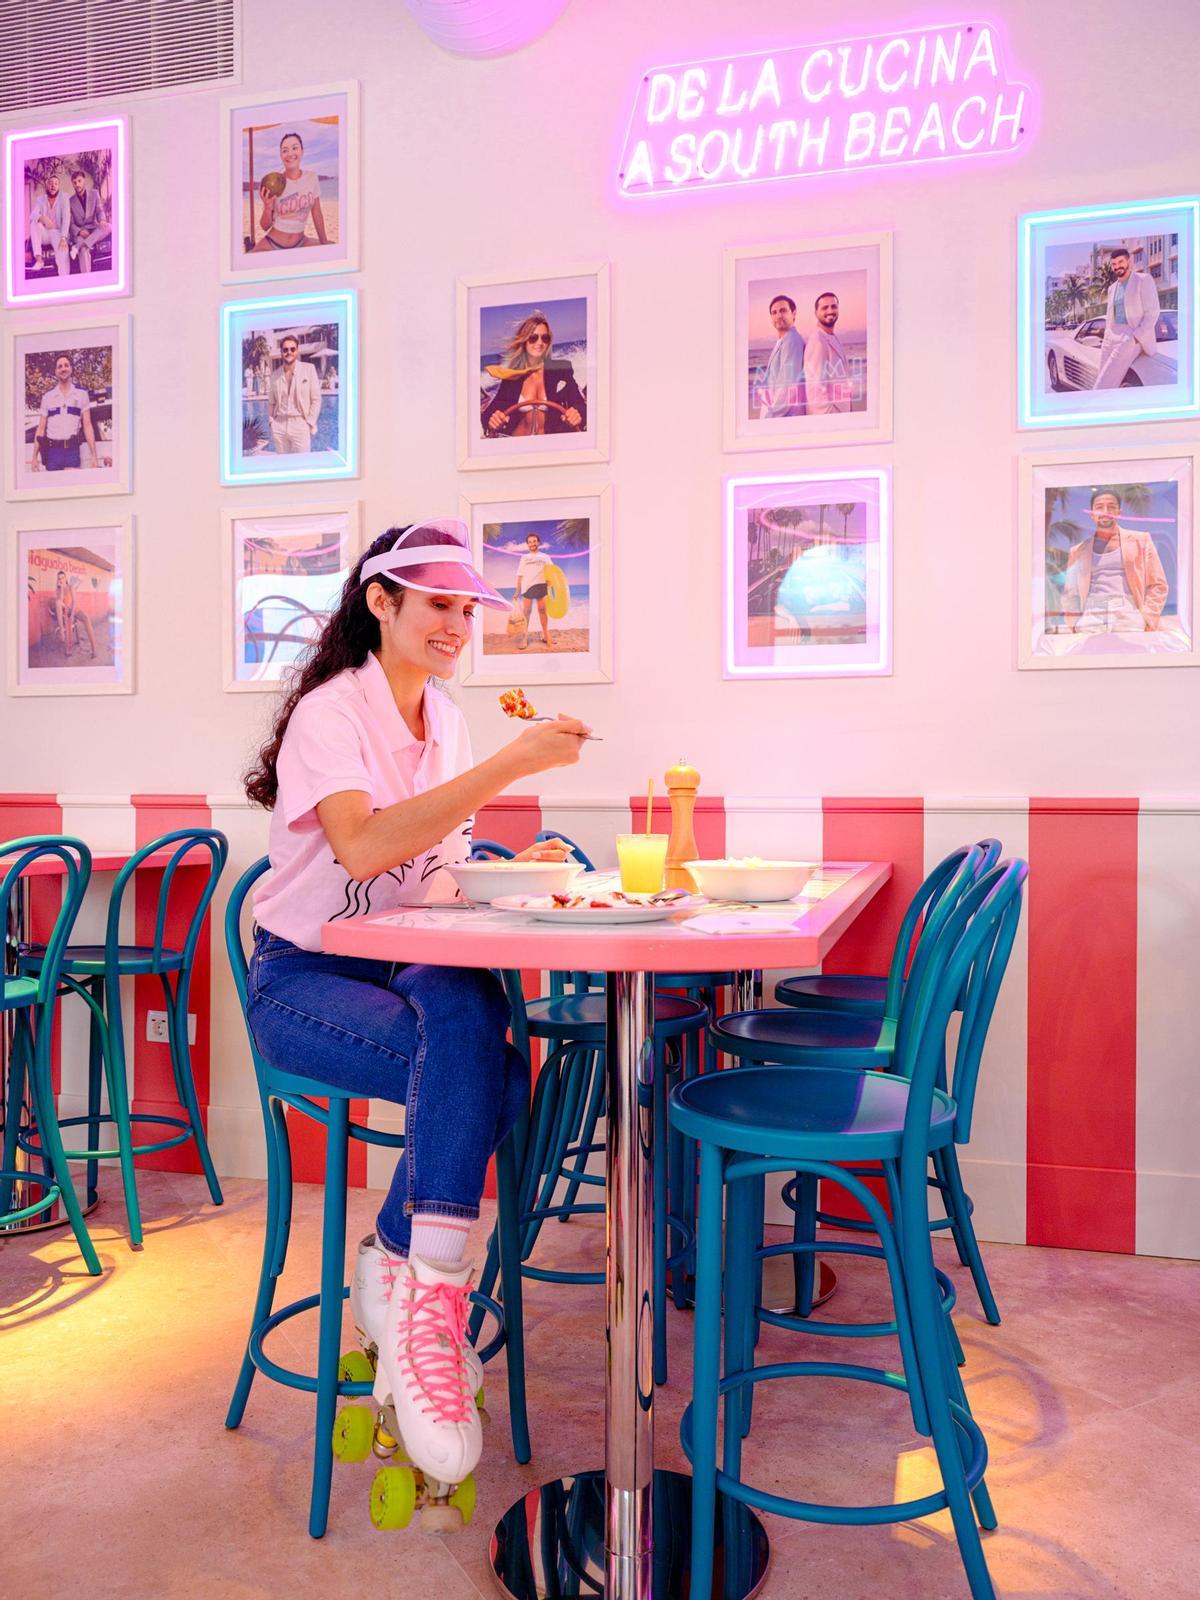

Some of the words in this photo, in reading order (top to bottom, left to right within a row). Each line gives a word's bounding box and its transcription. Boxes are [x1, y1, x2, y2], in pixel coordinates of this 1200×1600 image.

[648, 67, 708, 123] DE
[716, 58, 780, 117] LA
[800, 29, 998, 103] CUCINA
[623, 141, 654, 189] A
[665, 118, 830, 184] SOUTH
[844, 91, 1025, 162] BEACH
